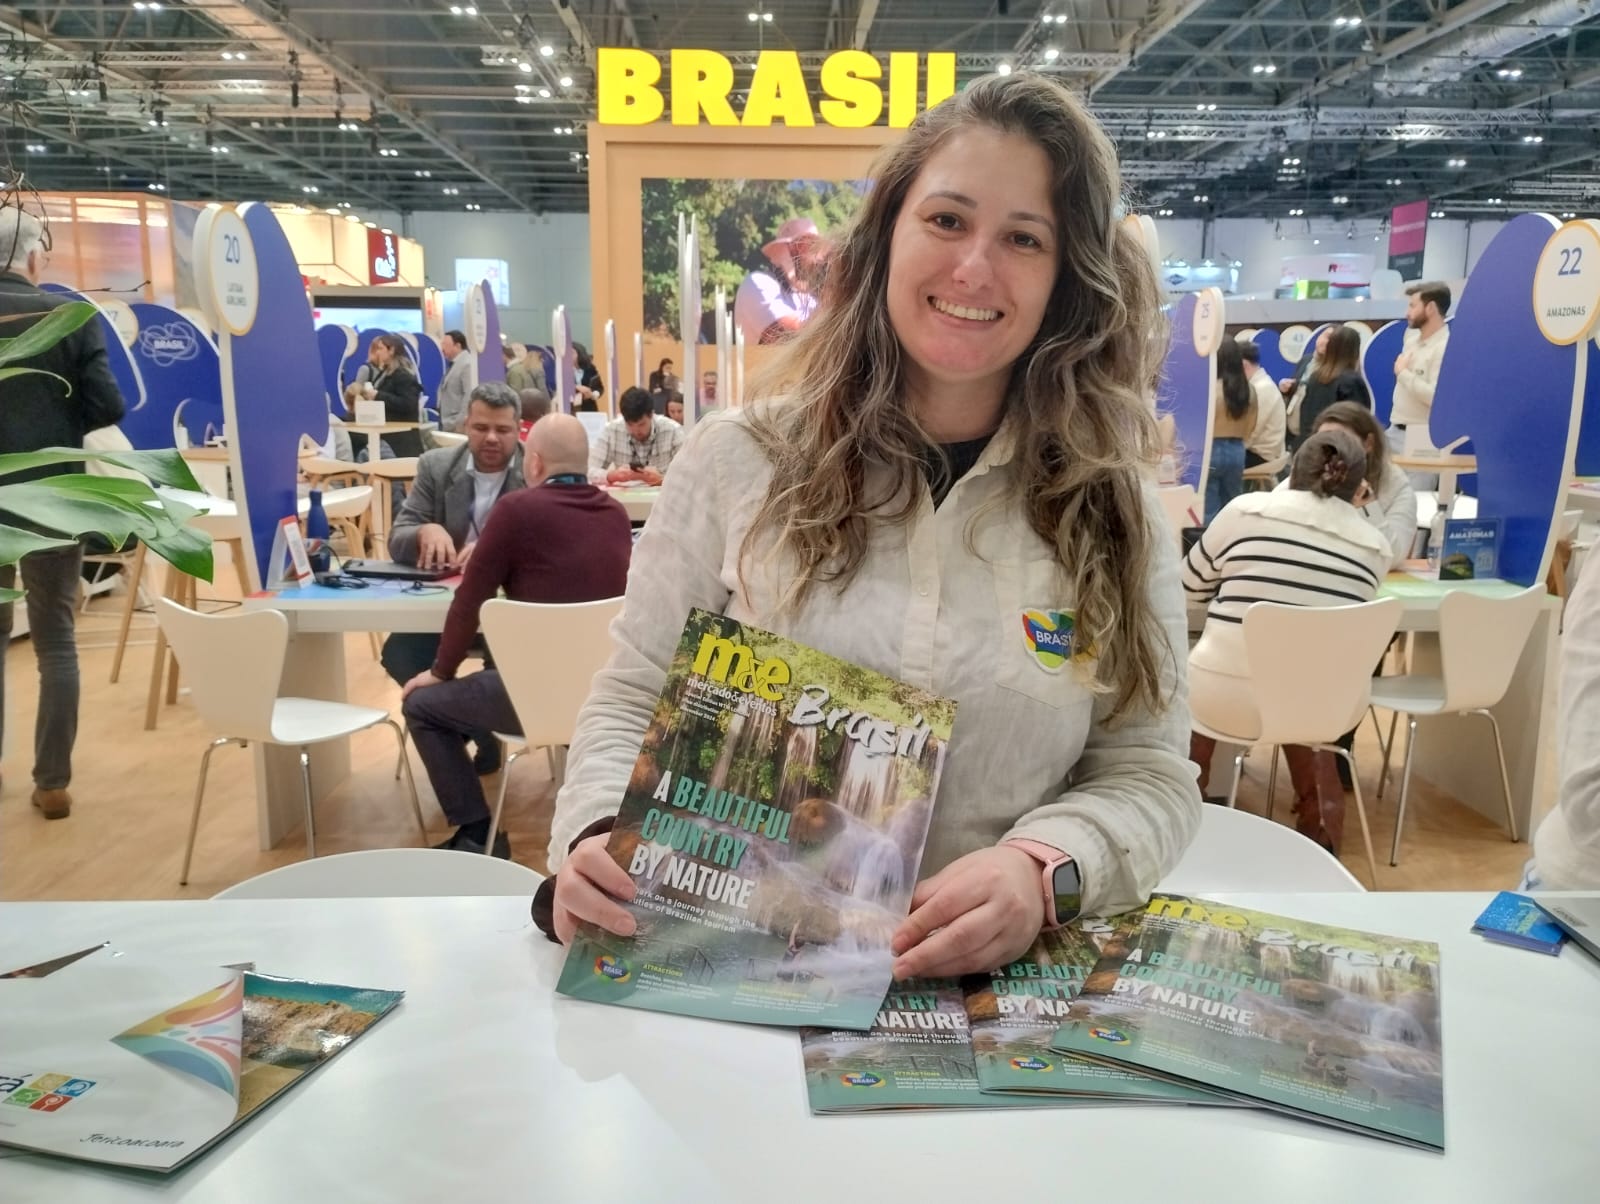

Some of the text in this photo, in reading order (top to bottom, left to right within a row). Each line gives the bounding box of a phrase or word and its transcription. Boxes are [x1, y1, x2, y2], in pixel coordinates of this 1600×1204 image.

[224, 233, 240, 264] 20
[1557, 246, 1583, 276] 22
[1546, 306, 1586, 318] AMAZONAS
[1035, 630, 1073, 647] BRASI
[787, 684, 931, 760] Brasil
[652, 770, 792, 845] A BEAUTIFUL
[640, 808, 749, 870] COUNTRY
[628, 843, 756, 910] BY NATURE
[654, 894, 666, 903] on
[672, 899, 706, 917] journey
[707, 909, 740, 925] through
[742, 918, 757, 929] the
[655, 904, 665, 913] of
[665, 907, 702, 923] Brazilian
[703, 918, 736, 933] tourism
[603, 965, 623, 976] BRASIL
[1119, 963, 1238, 1004] COUNTRY
[1126, 948, 1282, 997] A BEAUTIFUL
[996, 997, 1074, 1017] BY NA
[1111, 977, 1256, 1026] BY NATURE
[872, 1011, 969, 1030] NATURE
